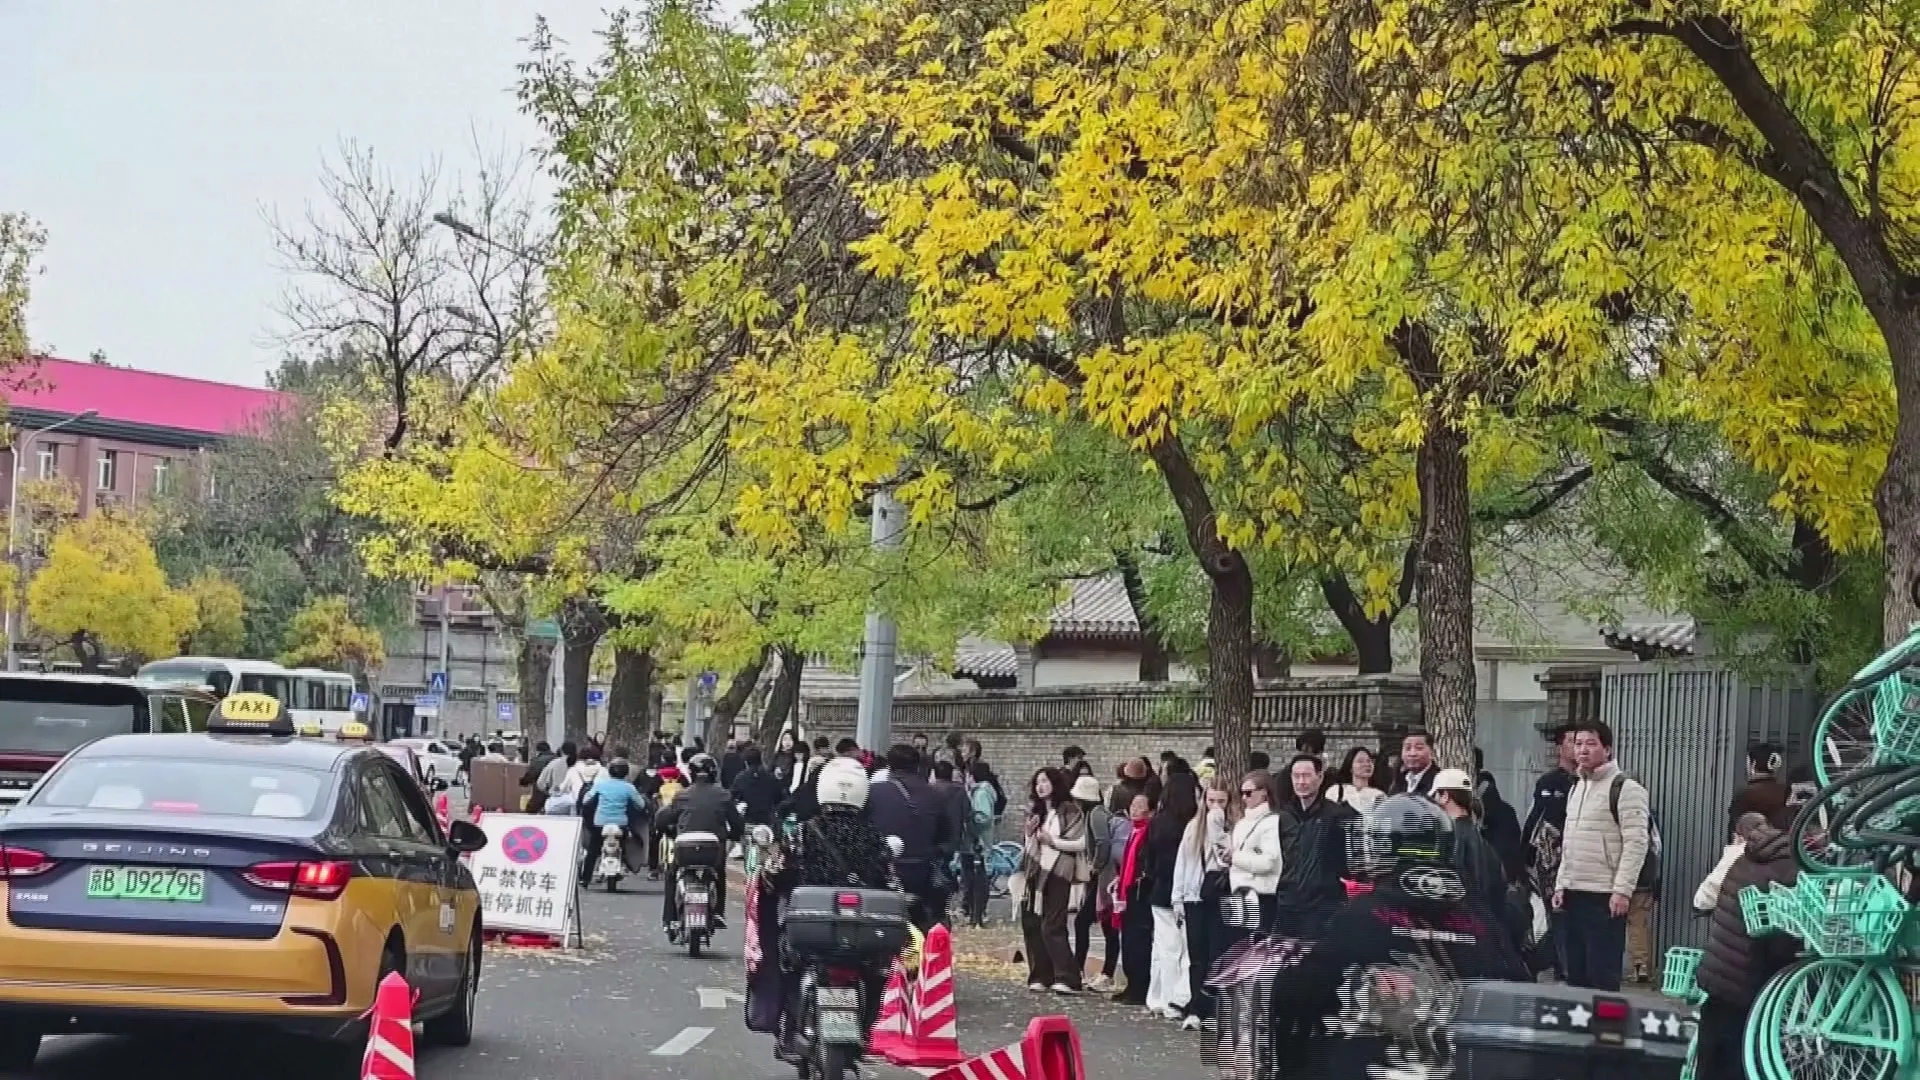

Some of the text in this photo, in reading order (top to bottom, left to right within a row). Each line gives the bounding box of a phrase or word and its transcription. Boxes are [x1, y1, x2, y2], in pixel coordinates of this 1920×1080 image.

[229, 700, 272, 714] TAXI
[83, 842, 211, 857] BEIJING
[479, 866, 557, 893] 严禁停车
